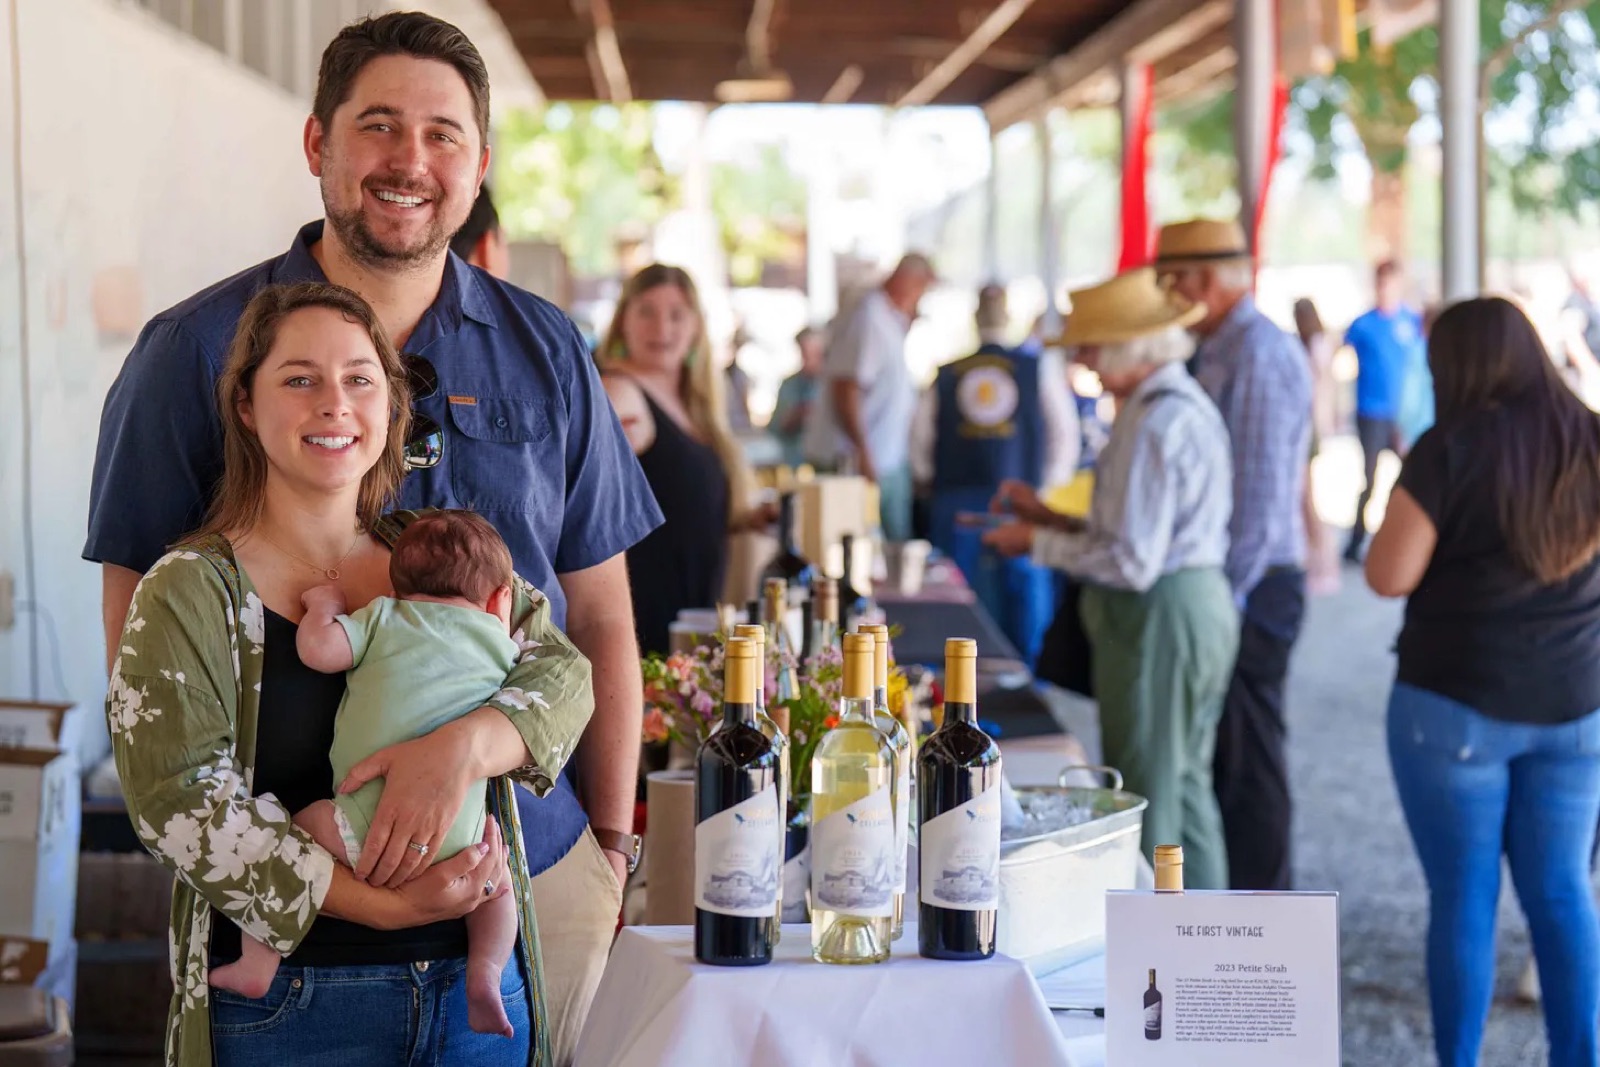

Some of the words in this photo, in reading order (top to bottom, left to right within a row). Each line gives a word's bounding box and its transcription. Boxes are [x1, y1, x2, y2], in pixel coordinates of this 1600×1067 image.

[1176, 925, 1194, 937] THE
[1197, 925, 1222, 937] FIRST
[1226, 925, 1264, 938] VINTAGE
[1215, 964, 1235, 972] 2023
[1238, 964, 1262, 973] Petite
[1264, 964, 1288, 973] Sirah
